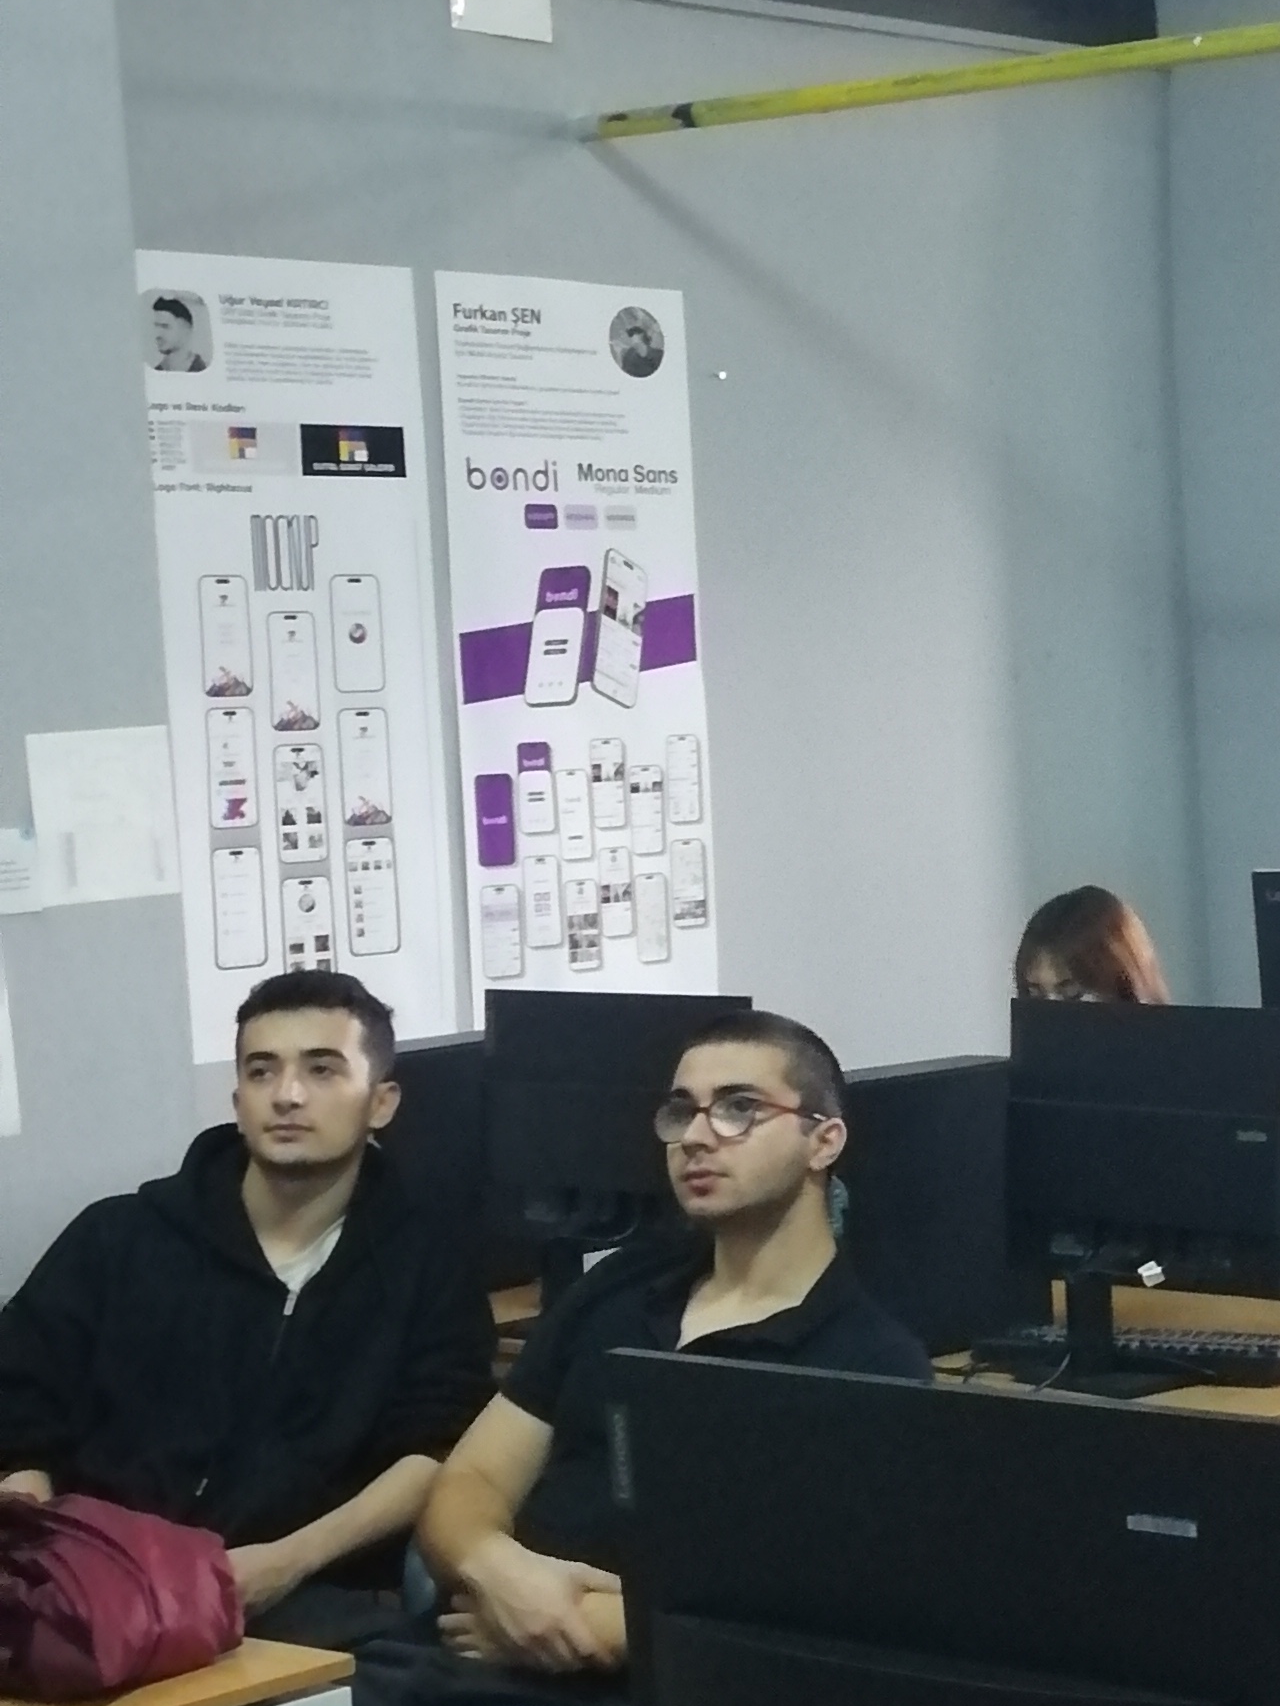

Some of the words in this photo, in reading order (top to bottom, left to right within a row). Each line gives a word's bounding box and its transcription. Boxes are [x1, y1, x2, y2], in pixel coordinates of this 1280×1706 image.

[452, 303, 507, 322] Furkan
[511, 308, 542, 326] ŞEN
[465, 456, 559, 492] bondi
[577, 462, 629, 483] Mona
[633, 465, 678, 484] Sans
